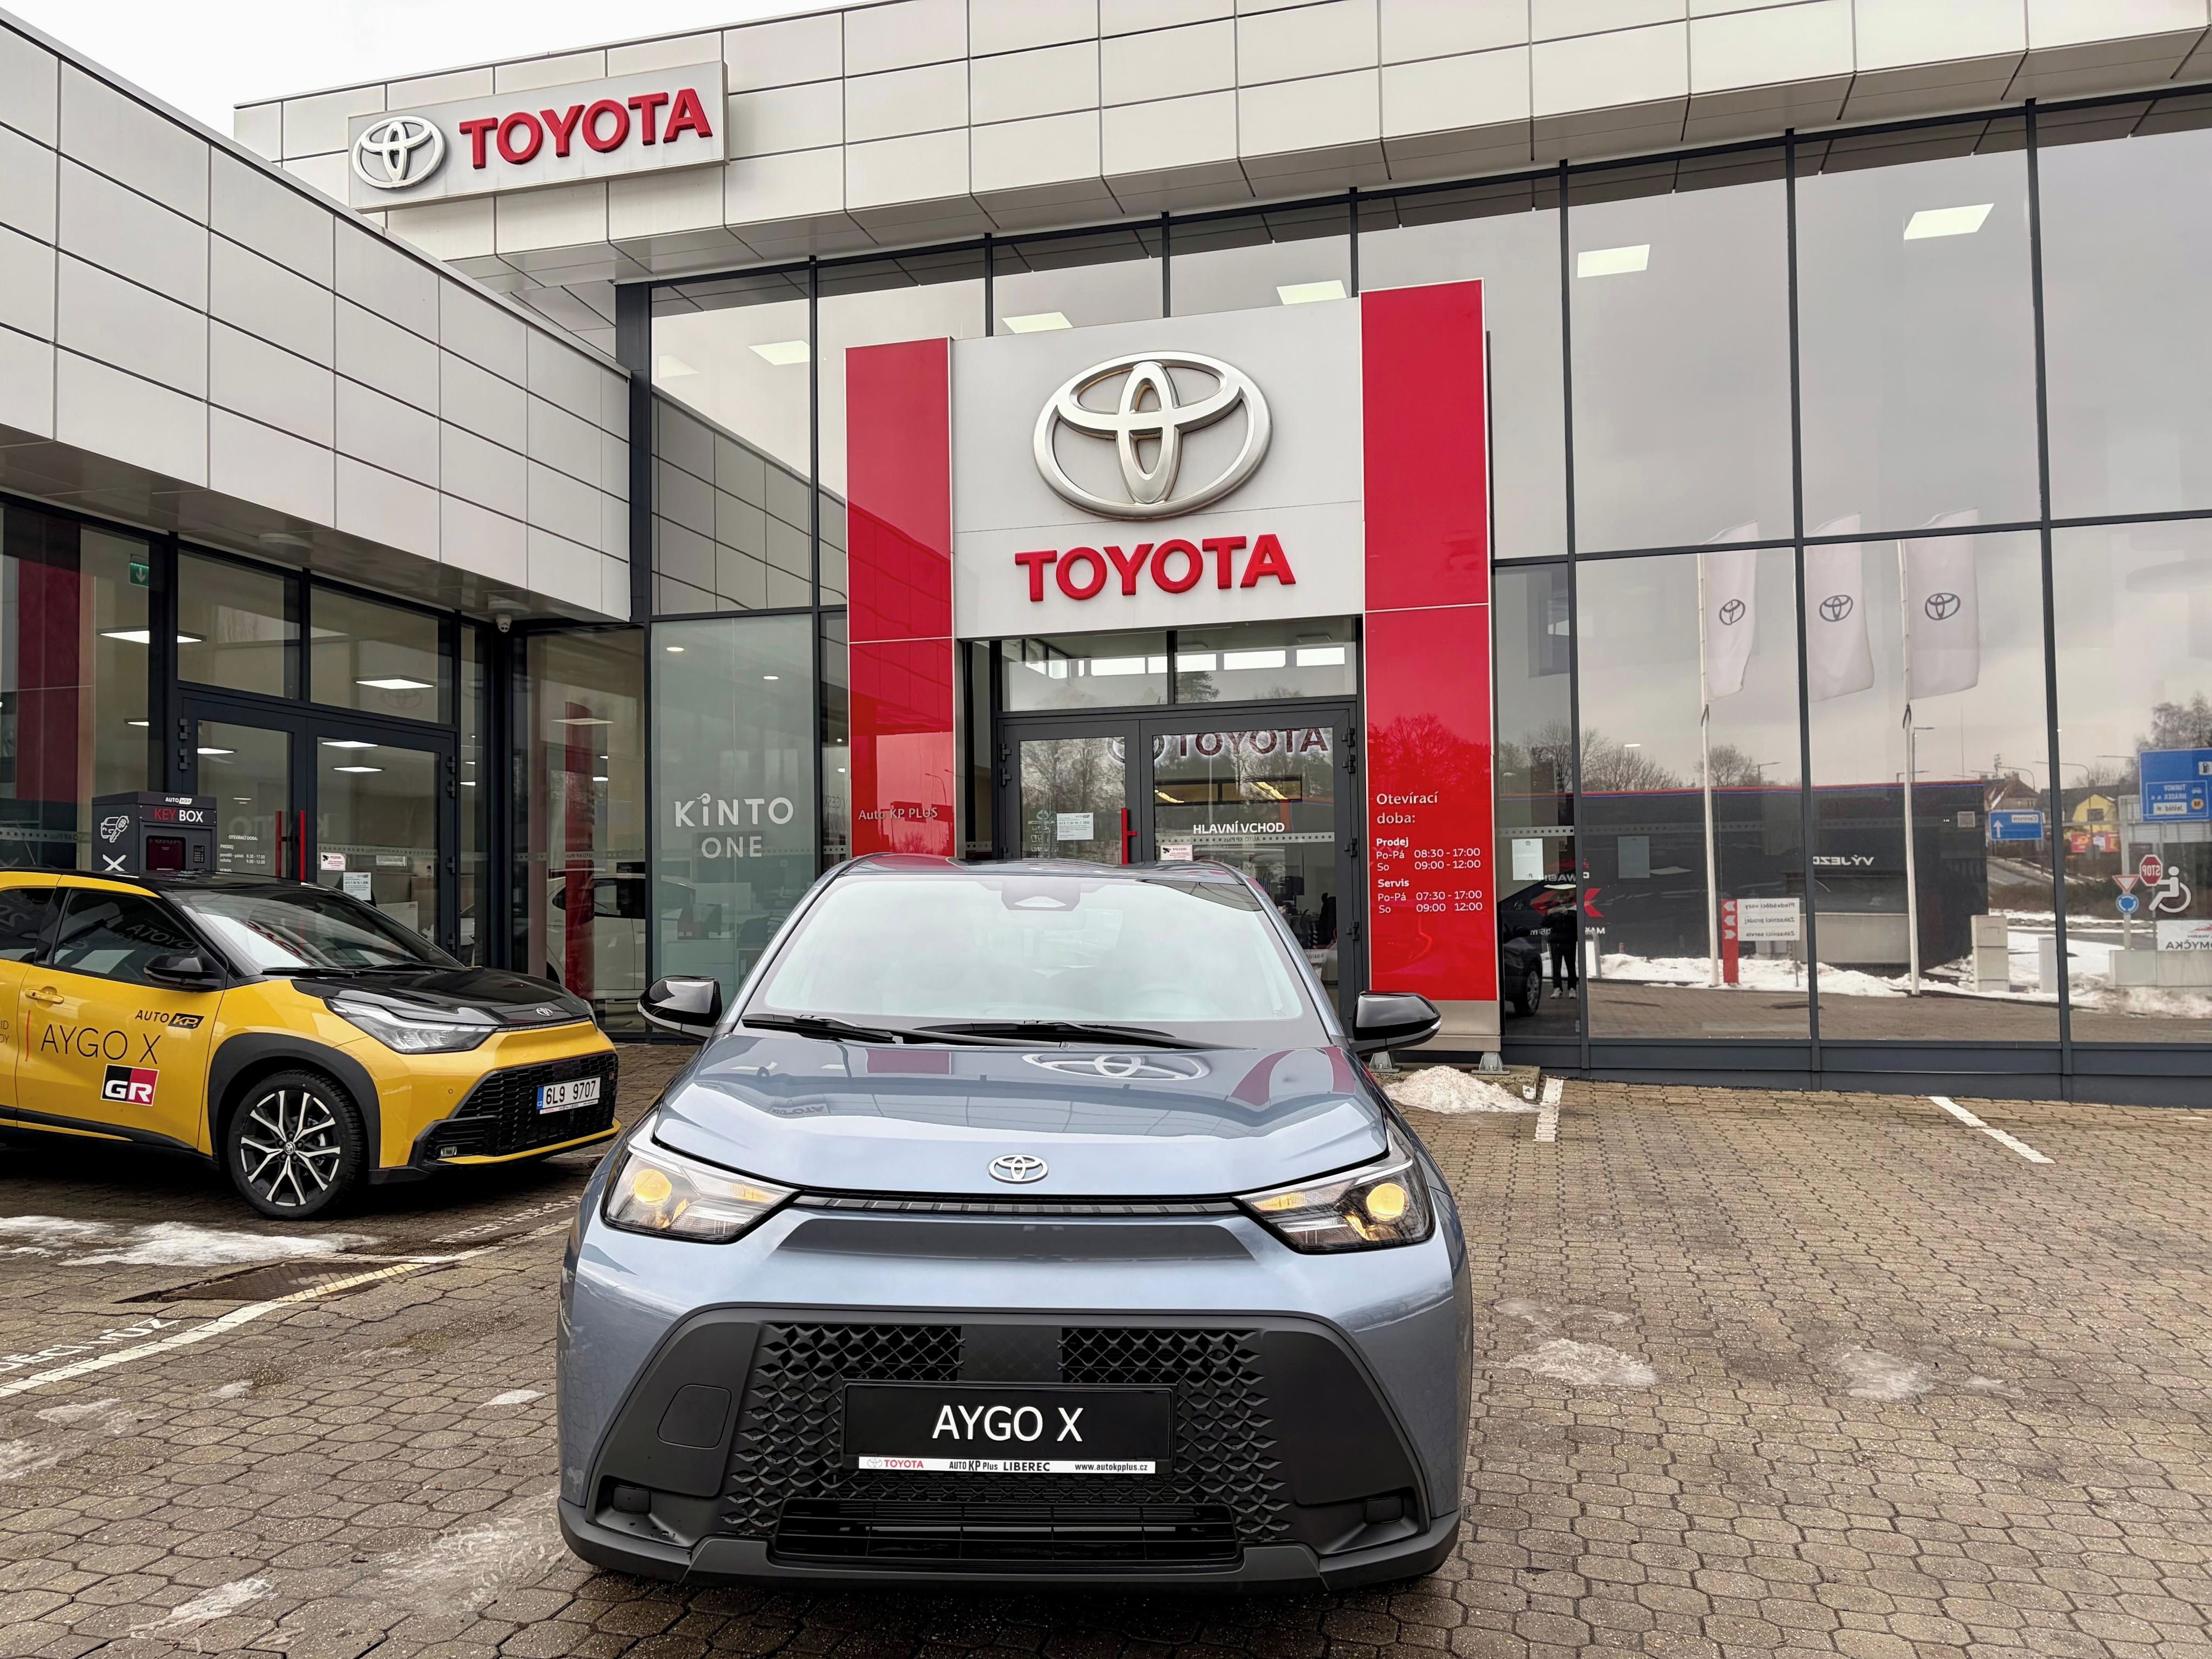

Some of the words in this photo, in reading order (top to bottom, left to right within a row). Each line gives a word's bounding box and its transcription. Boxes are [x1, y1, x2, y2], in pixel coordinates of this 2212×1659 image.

[459, 87, 713, 170] TOYOTA
[1015, 534, 1296, 602] TOYOTA
[1377, 791, 1439, 804] Otevírací
[154, 808, 177, 821] KEY
[179, 810, 203, 823] BOX
[858, 809, 886, 820] Auto
[889, 808, 905, 819] KP
[908, 807, 938, 819] PLUS
[1377, 812, 1415, 824] doba:
[1193, 820, 1238, 834] HLAVNÍ
[1240, 822, 1285, 833] VCHOD
[702, 836, 762, 859] ONE
[1376, 837, 1408, 847] Prodej
[1376, 850, 1405, 859] Po-Pá
[1414, 848, 1444, 858] 08:30
[1452, 848, 1480, 857] 17:00
[1377, 862, 1389, 871] So
[1414, 860, 1444, 869] 09:00
[1453, 860, 1481, 868] 12:00
[1378, 878, 1410, 888] Servis
[1378, 892, 1406, 901] Po-Pá
[1416, 891, 1445, 900] 07:30
[1454, 890, 1482, 899] 17:00
[1379, 905, 1391, 913] So
[1416, 903, 1446, 912] 09:00
[1454, 902, 1482, 911] 12:00
[134, 1010, 170, 1023] AUTO
[41, 1024, 128, 1061] AYGO
[139, 1033, 161, 1064] X
[105, 1080, 153, 1103] GR
[546, 1085, 565, 1105] 6L9
[572, 1080, 596, 1100] 9707
[932, 1405, 1043, 1441] AYGO
[1057, 1407, 1083, 1442] X
[884, 1459, 924, 1468] TOYOTA
[949, 1461, 967, 1470] AUTO
[968, 1460, 981, 1472] KP
[982, 1461, 998, 1471] Plus
[1003, 1461, 1050, 1472] LIBEREC
[1075, 1462, 1148, 1472] www.autokpplus.cz
